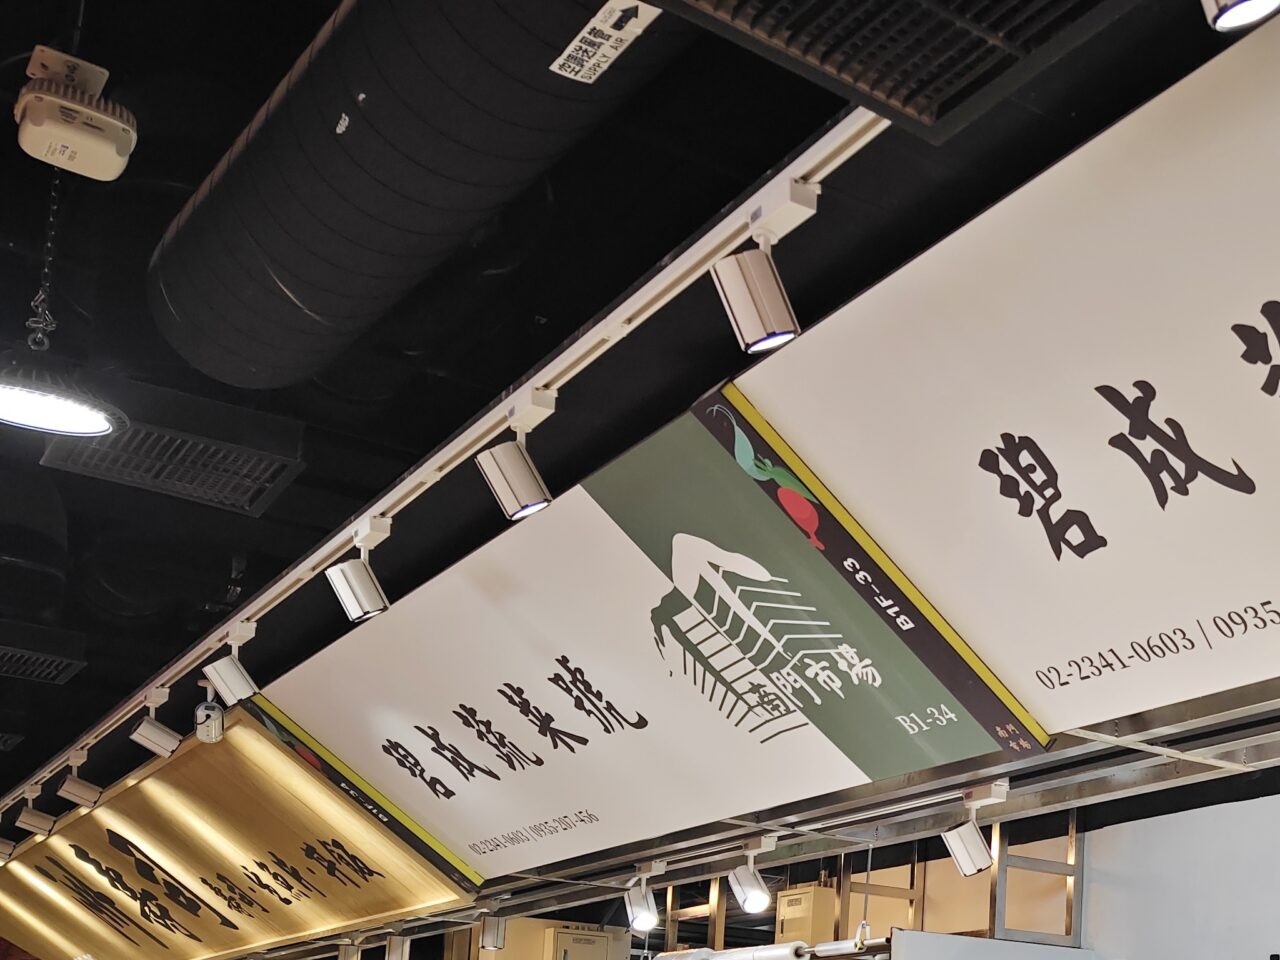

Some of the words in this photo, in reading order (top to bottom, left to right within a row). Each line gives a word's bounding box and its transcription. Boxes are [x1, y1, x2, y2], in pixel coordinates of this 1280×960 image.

[580, 53, 611, 80] SUPPLY
[609, 36, 625, 51] AIR
[843, 557, 916, 632] B1F-33
[1036, 626, 1198, 692] 02-2341-0603
[382, 655, 648, 800] 碧成蔬菜號
[895, 703, 958, 735] B1-34
[468, 830, 530, 855] 02-2341-0603
[528, 809, 600, 838] 0935-207-456
